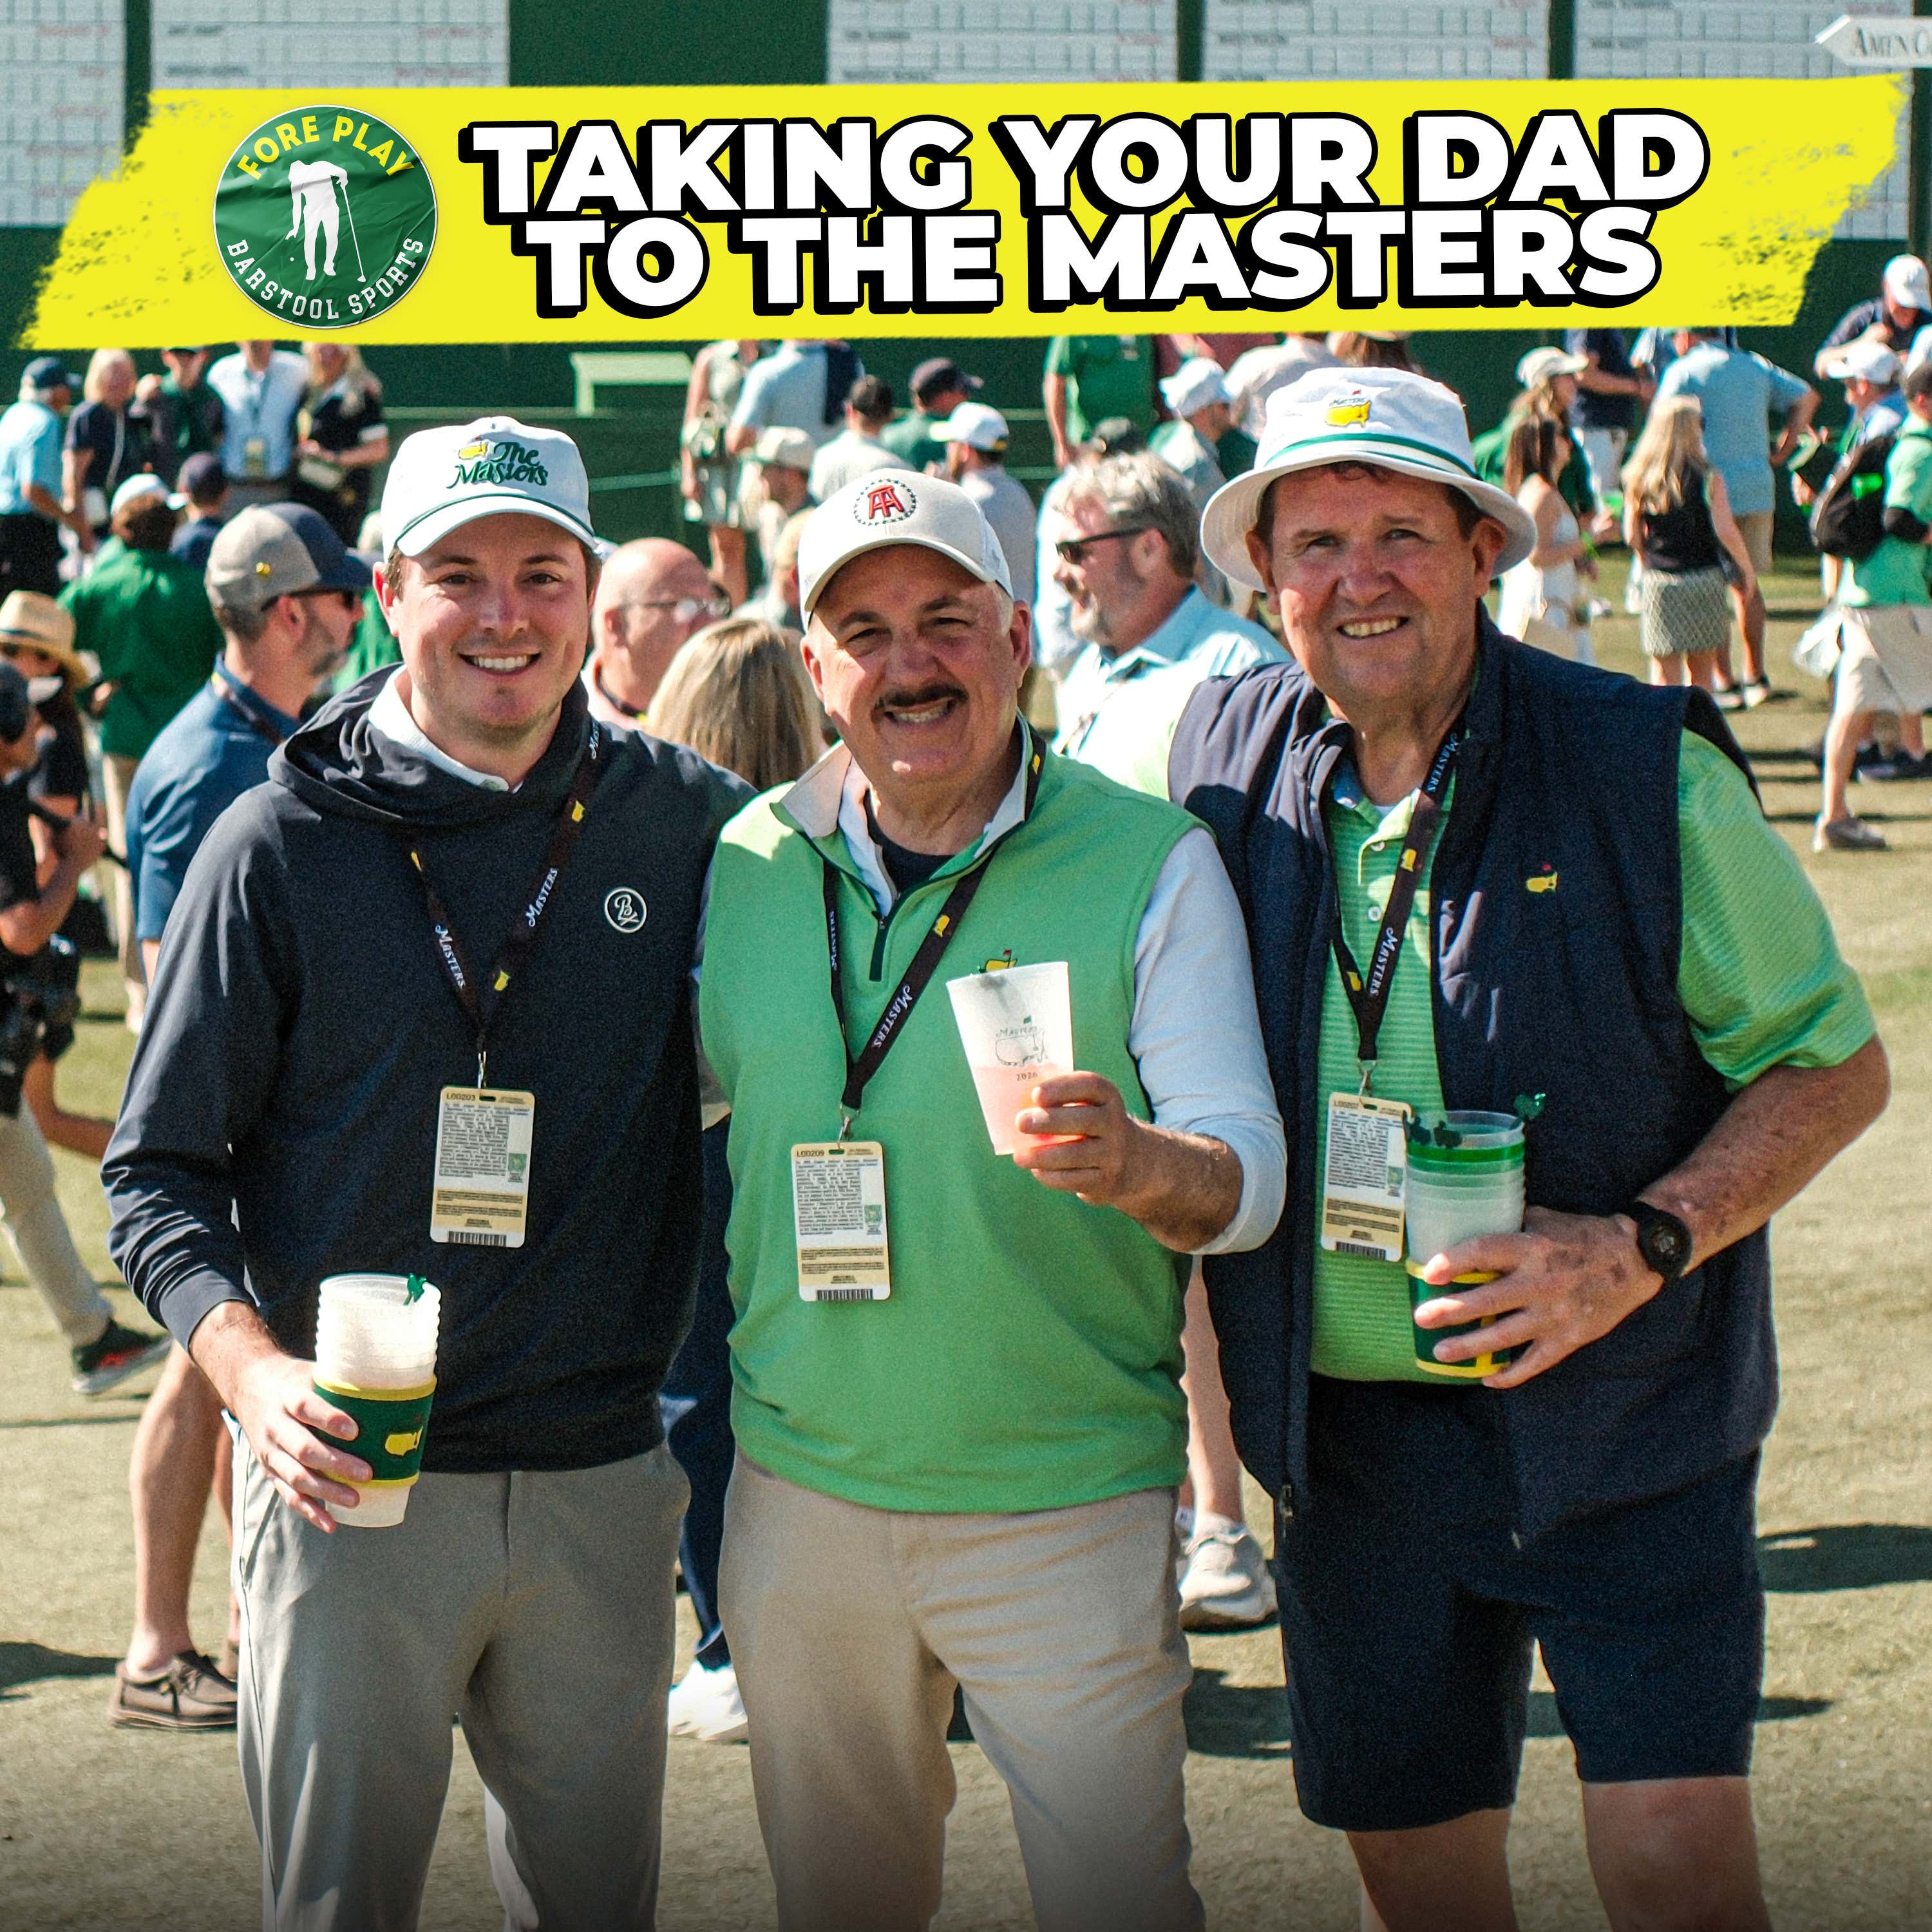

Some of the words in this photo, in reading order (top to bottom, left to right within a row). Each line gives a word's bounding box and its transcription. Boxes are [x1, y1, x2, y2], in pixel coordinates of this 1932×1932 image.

[491, 442, 540, 466] The
[446, 460, 548, 489] Masters
[1016, 1072, 1038, 1081] 2026
